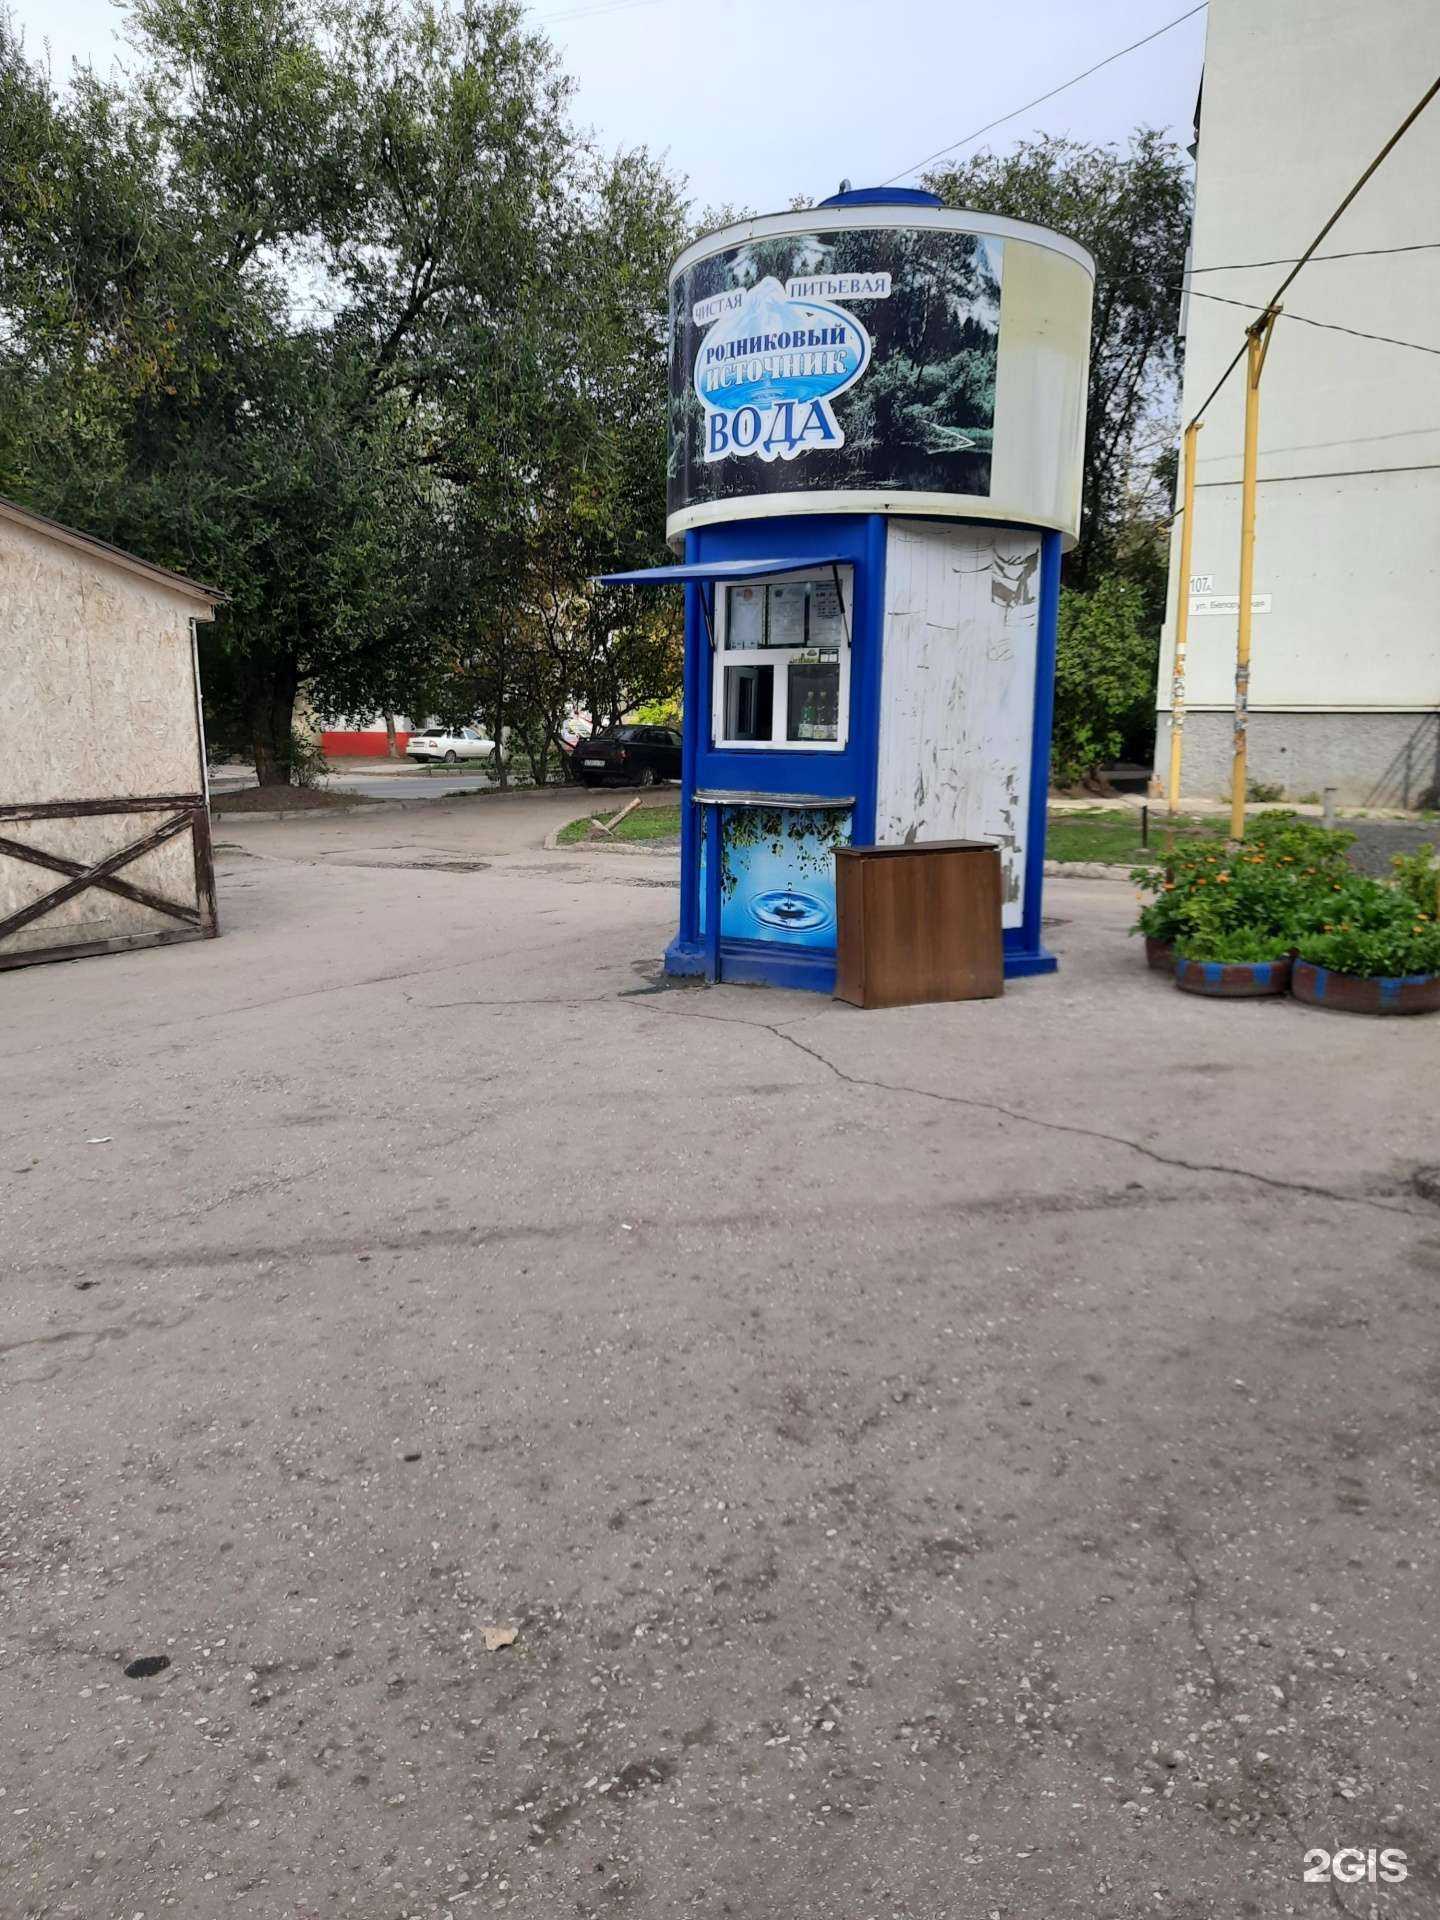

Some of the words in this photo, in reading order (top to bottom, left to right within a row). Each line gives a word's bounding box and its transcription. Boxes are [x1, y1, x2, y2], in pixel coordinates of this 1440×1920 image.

[695, 293, 742, 320] ЧИСТАЯ
[789, 277, 886, 298] ПИТЬЕВАЯ
[706, 323, 847, 364] РОДНИКОВЫЙ
[705, 350, 849, 392] ИСТОЧНИК
[709, 400, 836, 454] ВОДА
